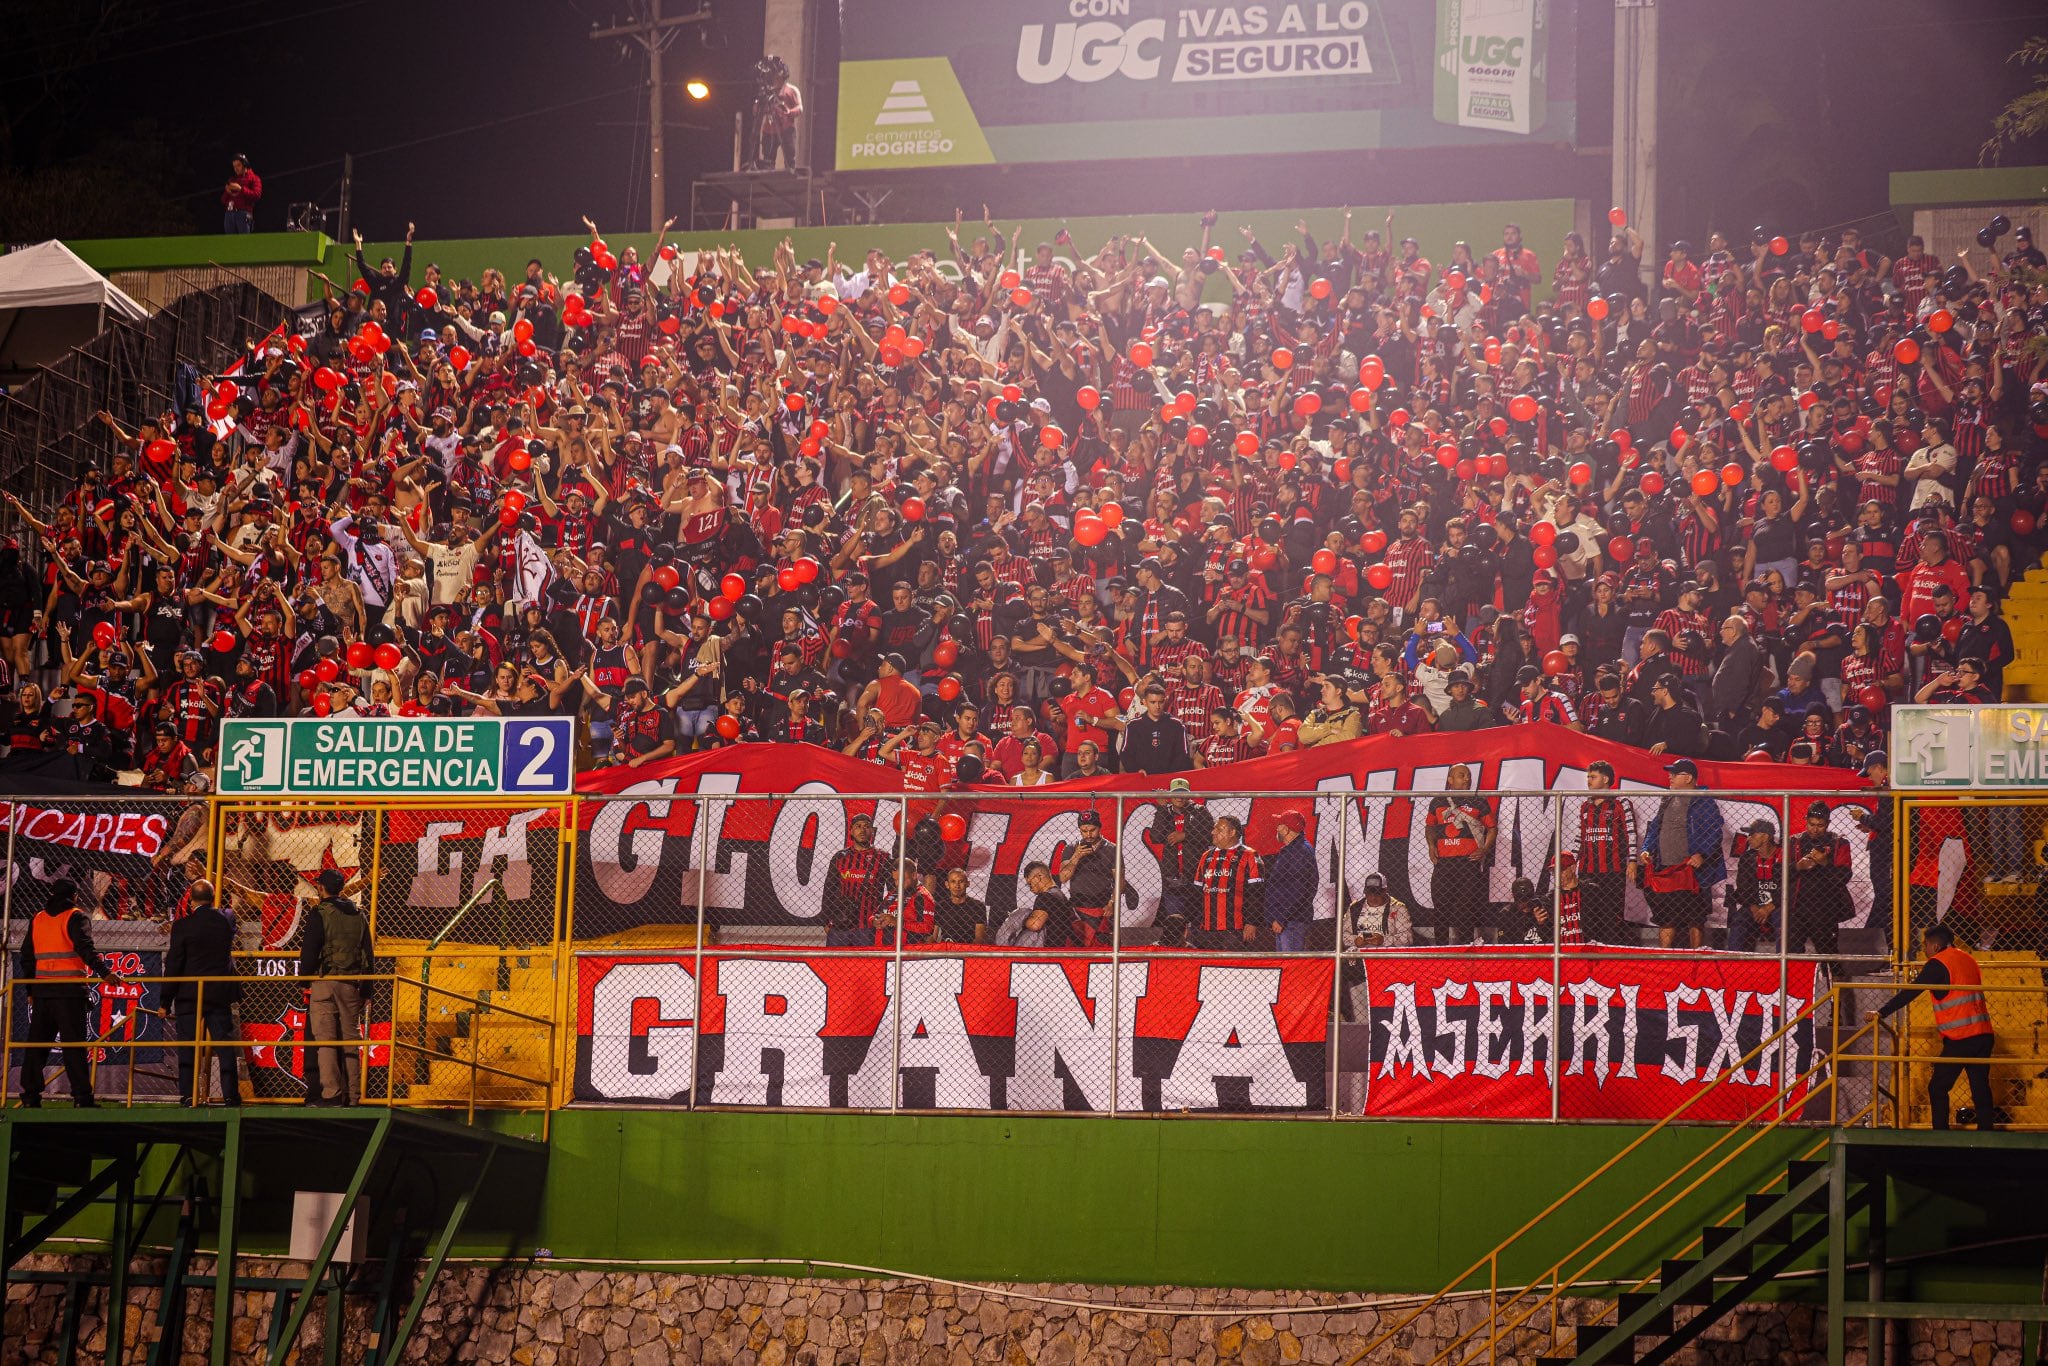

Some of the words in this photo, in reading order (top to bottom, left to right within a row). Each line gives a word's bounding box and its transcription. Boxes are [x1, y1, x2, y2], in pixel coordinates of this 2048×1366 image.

[1070, 0, 1129, 17] CON
[1177, 7, 1269, 38] ¡VAS
[1276, 4, 1307, 34] A
[1316, 2, 1369, 32] LO
[1017, 19, 1166, 84] UGC
[1186, 41, 1360, 76] SEGURO!
[1461, 36, 1525, 67] UGC
[1468, 67, 1500, 76] 4060
[1501, 69, 1515, 77] PSI
[852, 139, 954, 157] PROGRESO
[866, 128, 942, 142] cementos
[316, 725, 429, 752] SALIDA
[434, 725, 475, 752] DE
[516, 726, 556, 786] 2
[293, 758, 496, 787] EMERGENCIA
[257, 959, 286, 976] LOS
[104, 985, 138, 997] L.D.A
[590, 958, 1308, 1110] GRANA
[1376, 976, 1641, 1090] ASERRI
